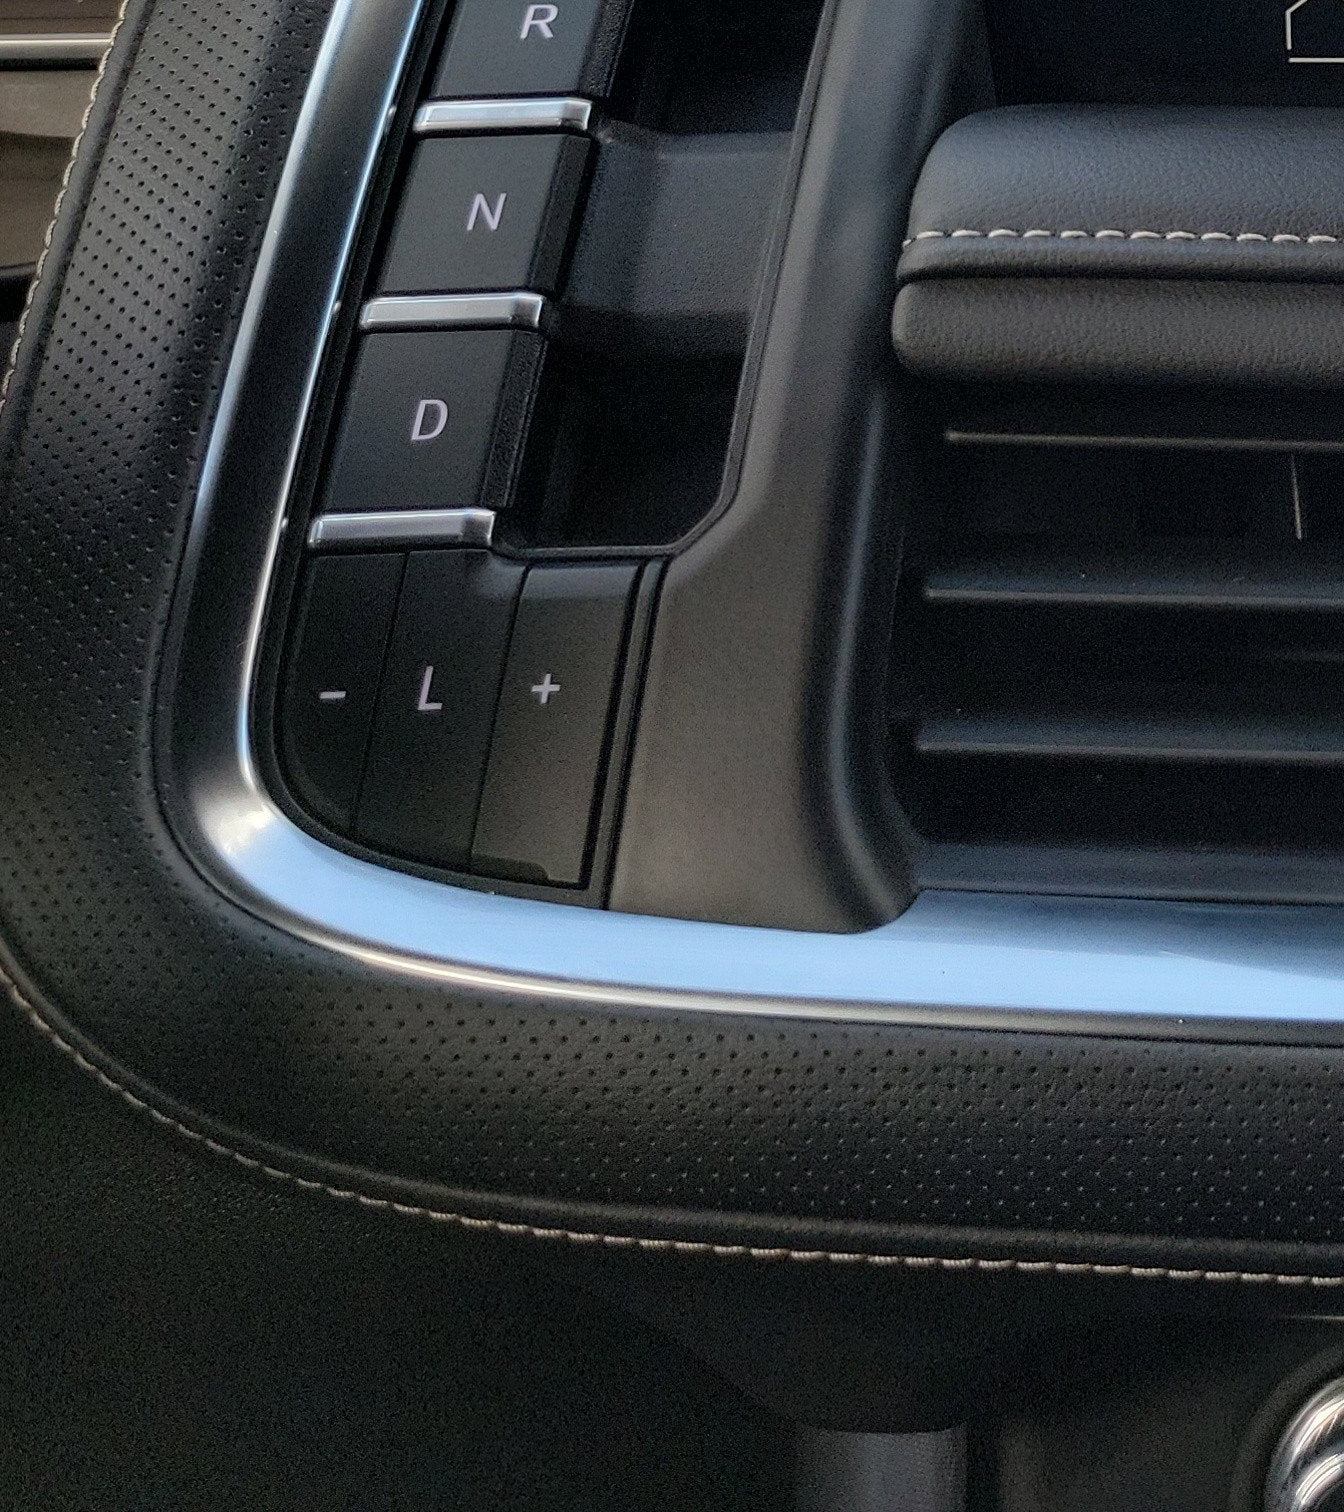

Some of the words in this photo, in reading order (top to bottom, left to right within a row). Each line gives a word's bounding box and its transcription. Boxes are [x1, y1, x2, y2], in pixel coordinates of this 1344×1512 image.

[518, 2, 561, 41] R
[464, 192, 508, 232] N
[410, 398, 449, 441] D
[417, 666, 442, 711] L
